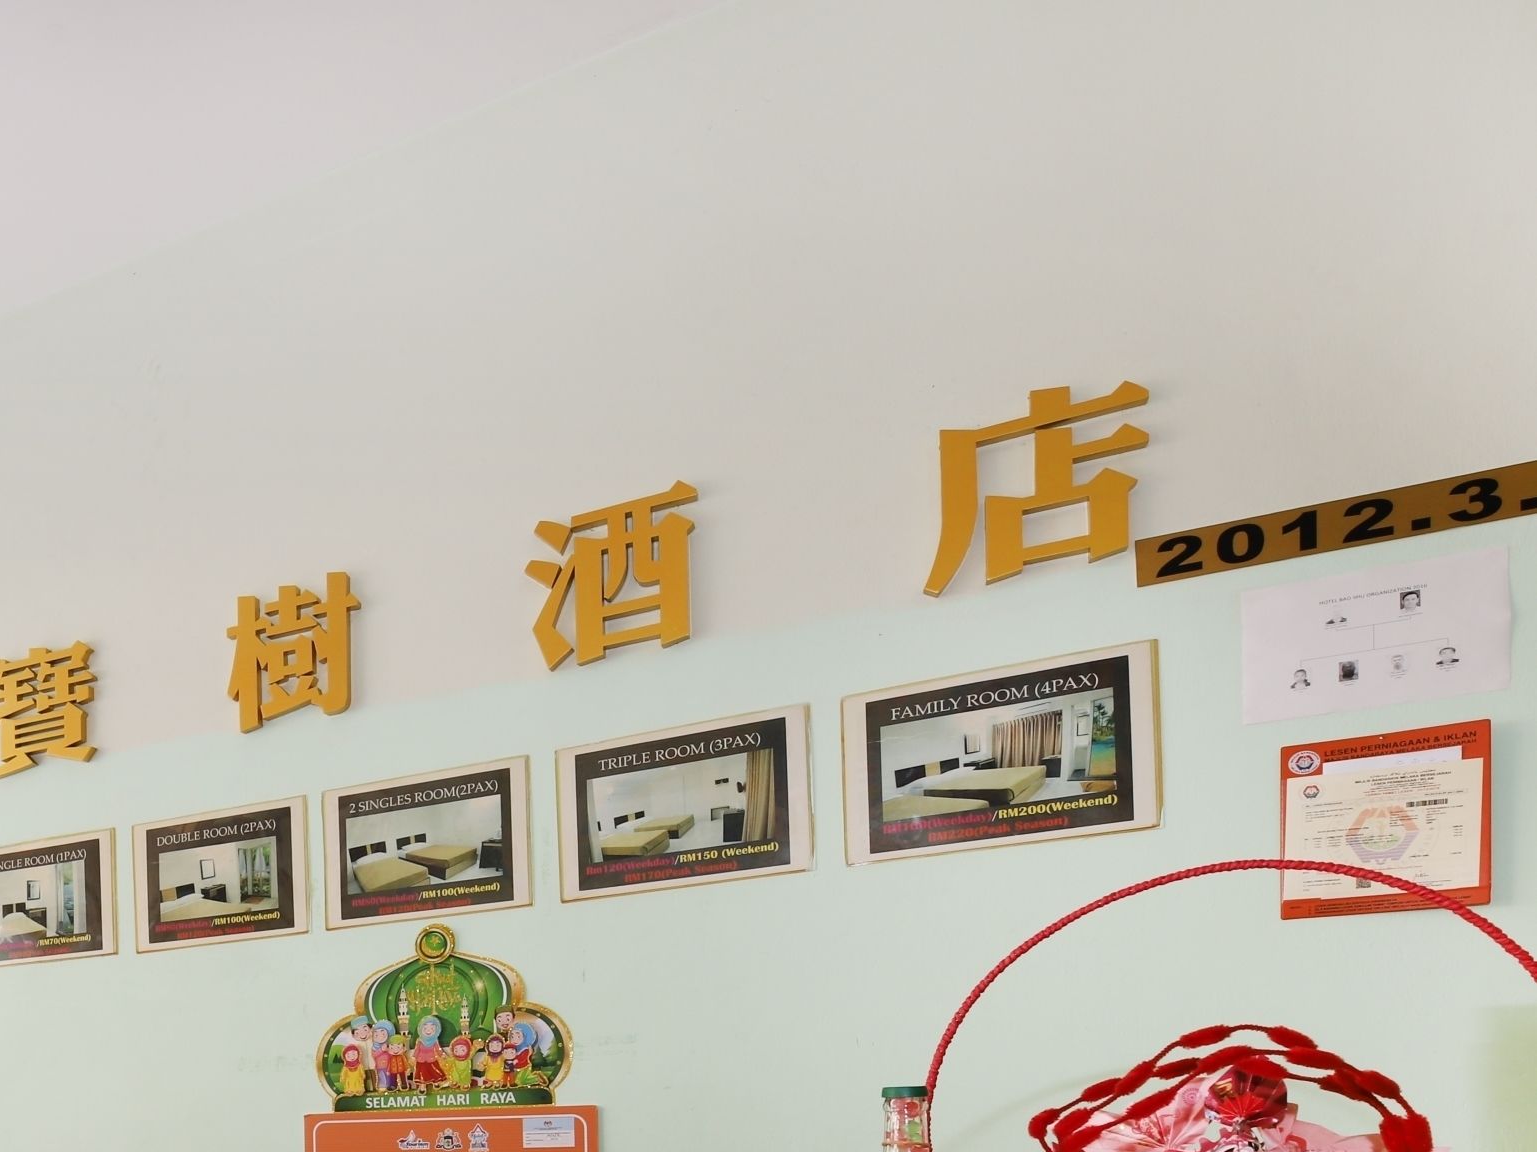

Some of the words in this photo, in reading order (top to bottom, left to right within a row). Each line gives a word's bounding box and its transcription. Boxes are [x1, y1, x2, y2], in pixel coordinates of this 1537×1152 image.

[890, 696, 961, 721] FAMILY
[967, 687, 1028, 708] ROOM
[1034, 672, 1099, 699] (4PAX)
[598, 751, 651, 772] TRIPLE
[655, 742, 705, 762] ROOM
[709, 732, 762, 756] (3PAX)
[1323, 746, 1360, 757] LESEN
[1362, 737, 1431, 753] PERNIAGAAN
[1443, 730, 1478, 742] IKLAN
[349, 803, 357, 814] 2
[358, 793, 412, 812] SINGLES
[414, 779, 499, 804] ROOM(2PAX)
[156, 830, 201, 847] DOUBLE
[203, 824, 238, 841] ROOM
[240, 818, 277, 836] (2PAX)
[24, 853, 55, 867] ROOM
[56, 848, 88, 864] (1PAX)
[721, 841, 780, 860] (Weekend)
[366, 1095, 427, 1109] SELAMAT
[437, 1093, 470, 1106] HARI
[480, 1091, 517, 1105] RAYA
